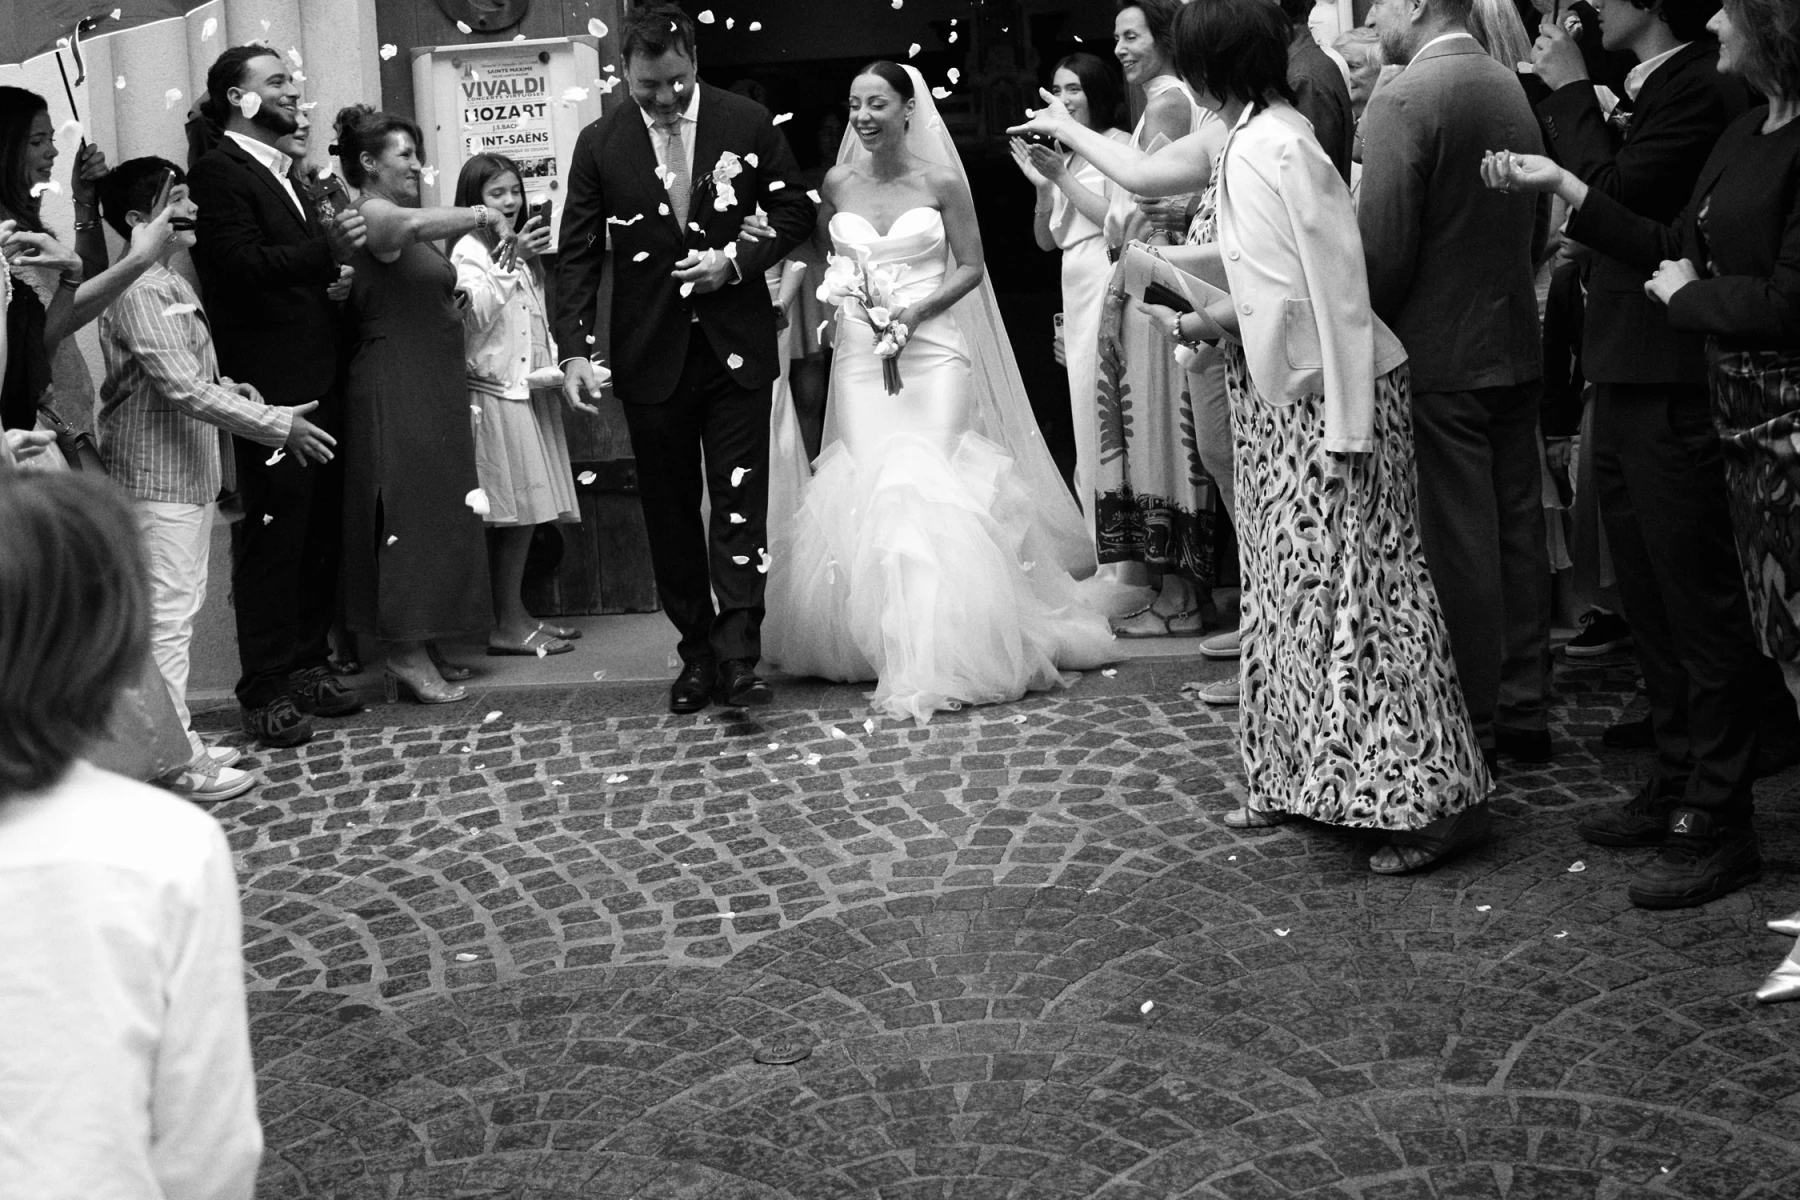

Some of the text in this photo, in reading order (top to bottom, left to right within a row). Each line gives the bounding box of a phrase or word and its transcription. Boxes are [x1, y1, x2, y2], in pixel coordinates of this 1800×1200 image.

[461, 76, 545, 98] VIVALDI
[464, 103, 547, 122] MOZART
[466, 131, 549, 147] SINT-SAËNS
